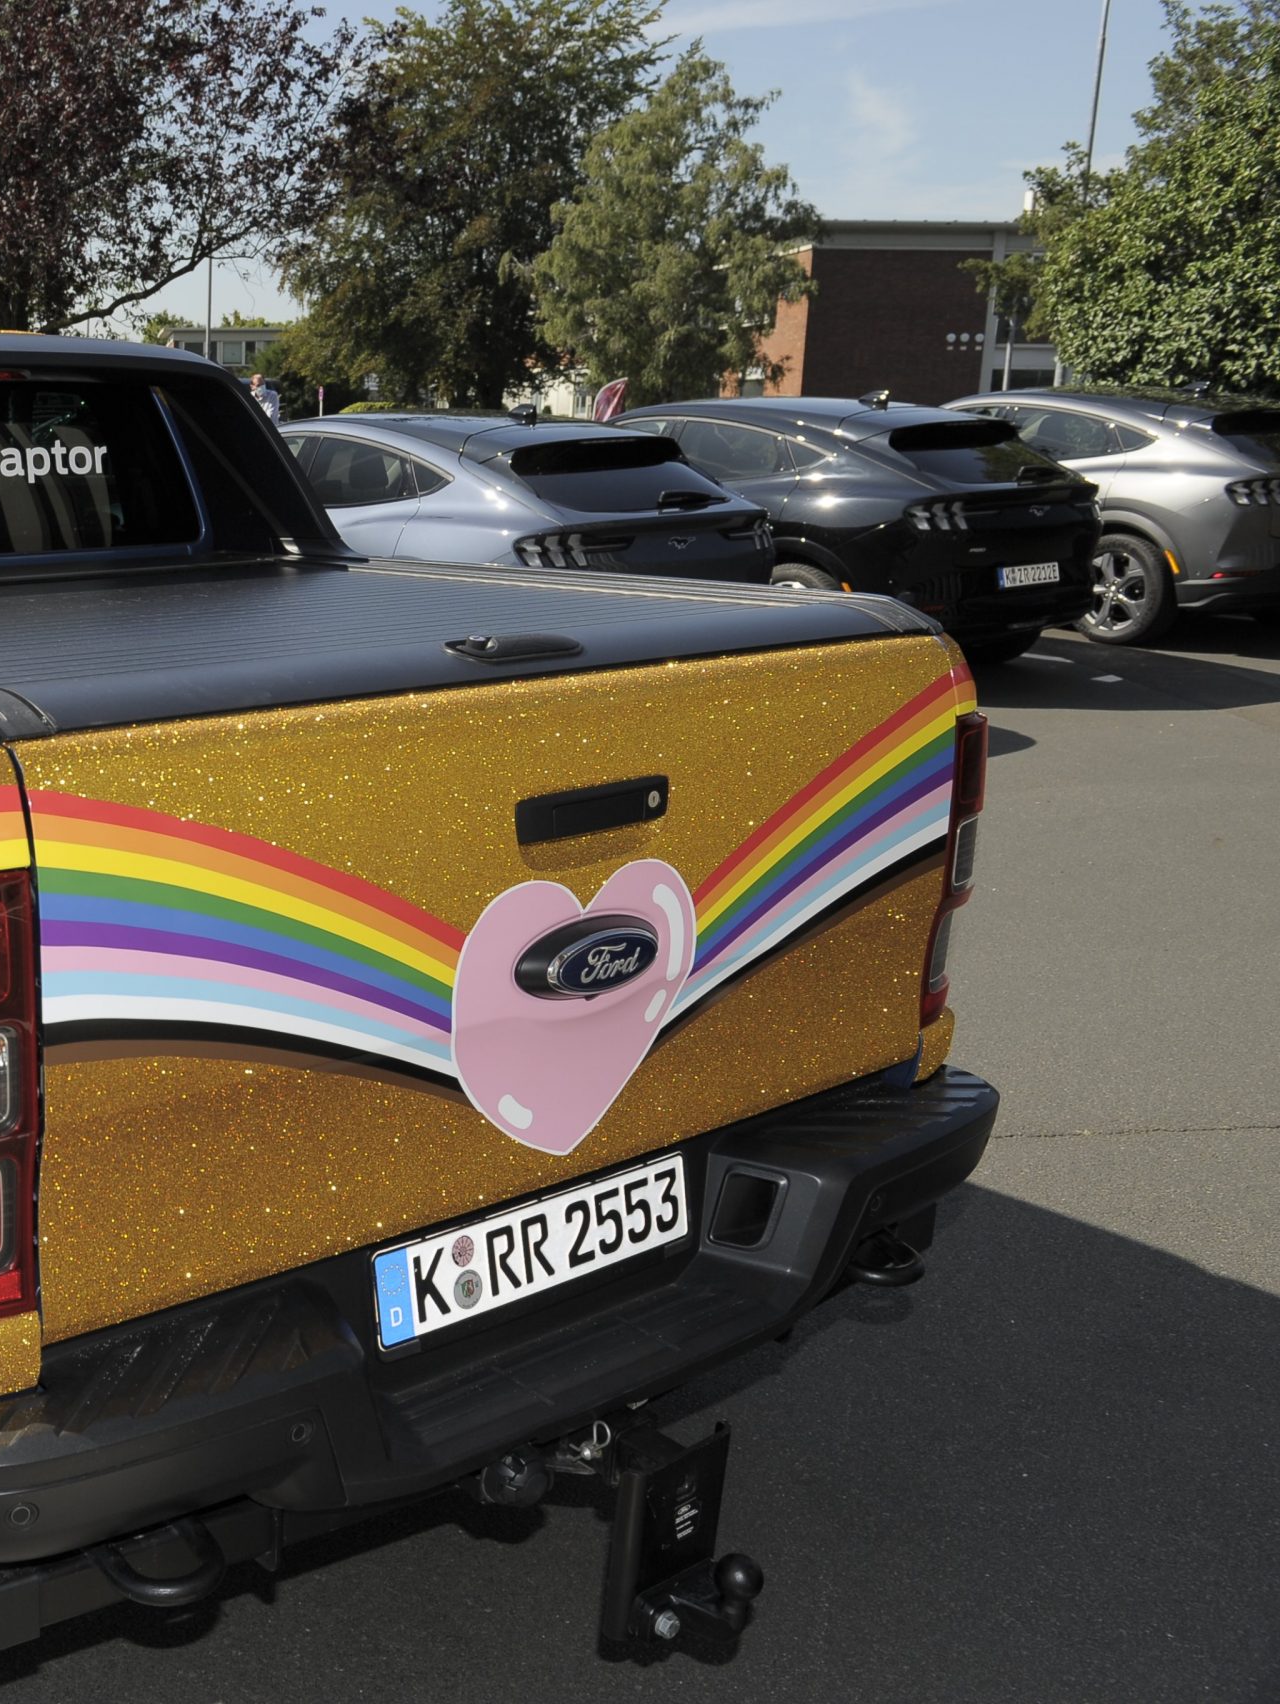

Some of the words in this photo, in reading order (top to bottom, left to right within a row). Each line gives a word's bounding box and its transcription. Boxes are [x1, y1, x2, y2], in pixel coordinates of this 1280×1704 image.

[580, 942, 641, 984] Ford
[412, 1246, 451, 1324] K
[485, 1213, 556, 1297] RR
[564, 1167, 680, 1269] 2553
[389, 1306, 404, 1328] D
